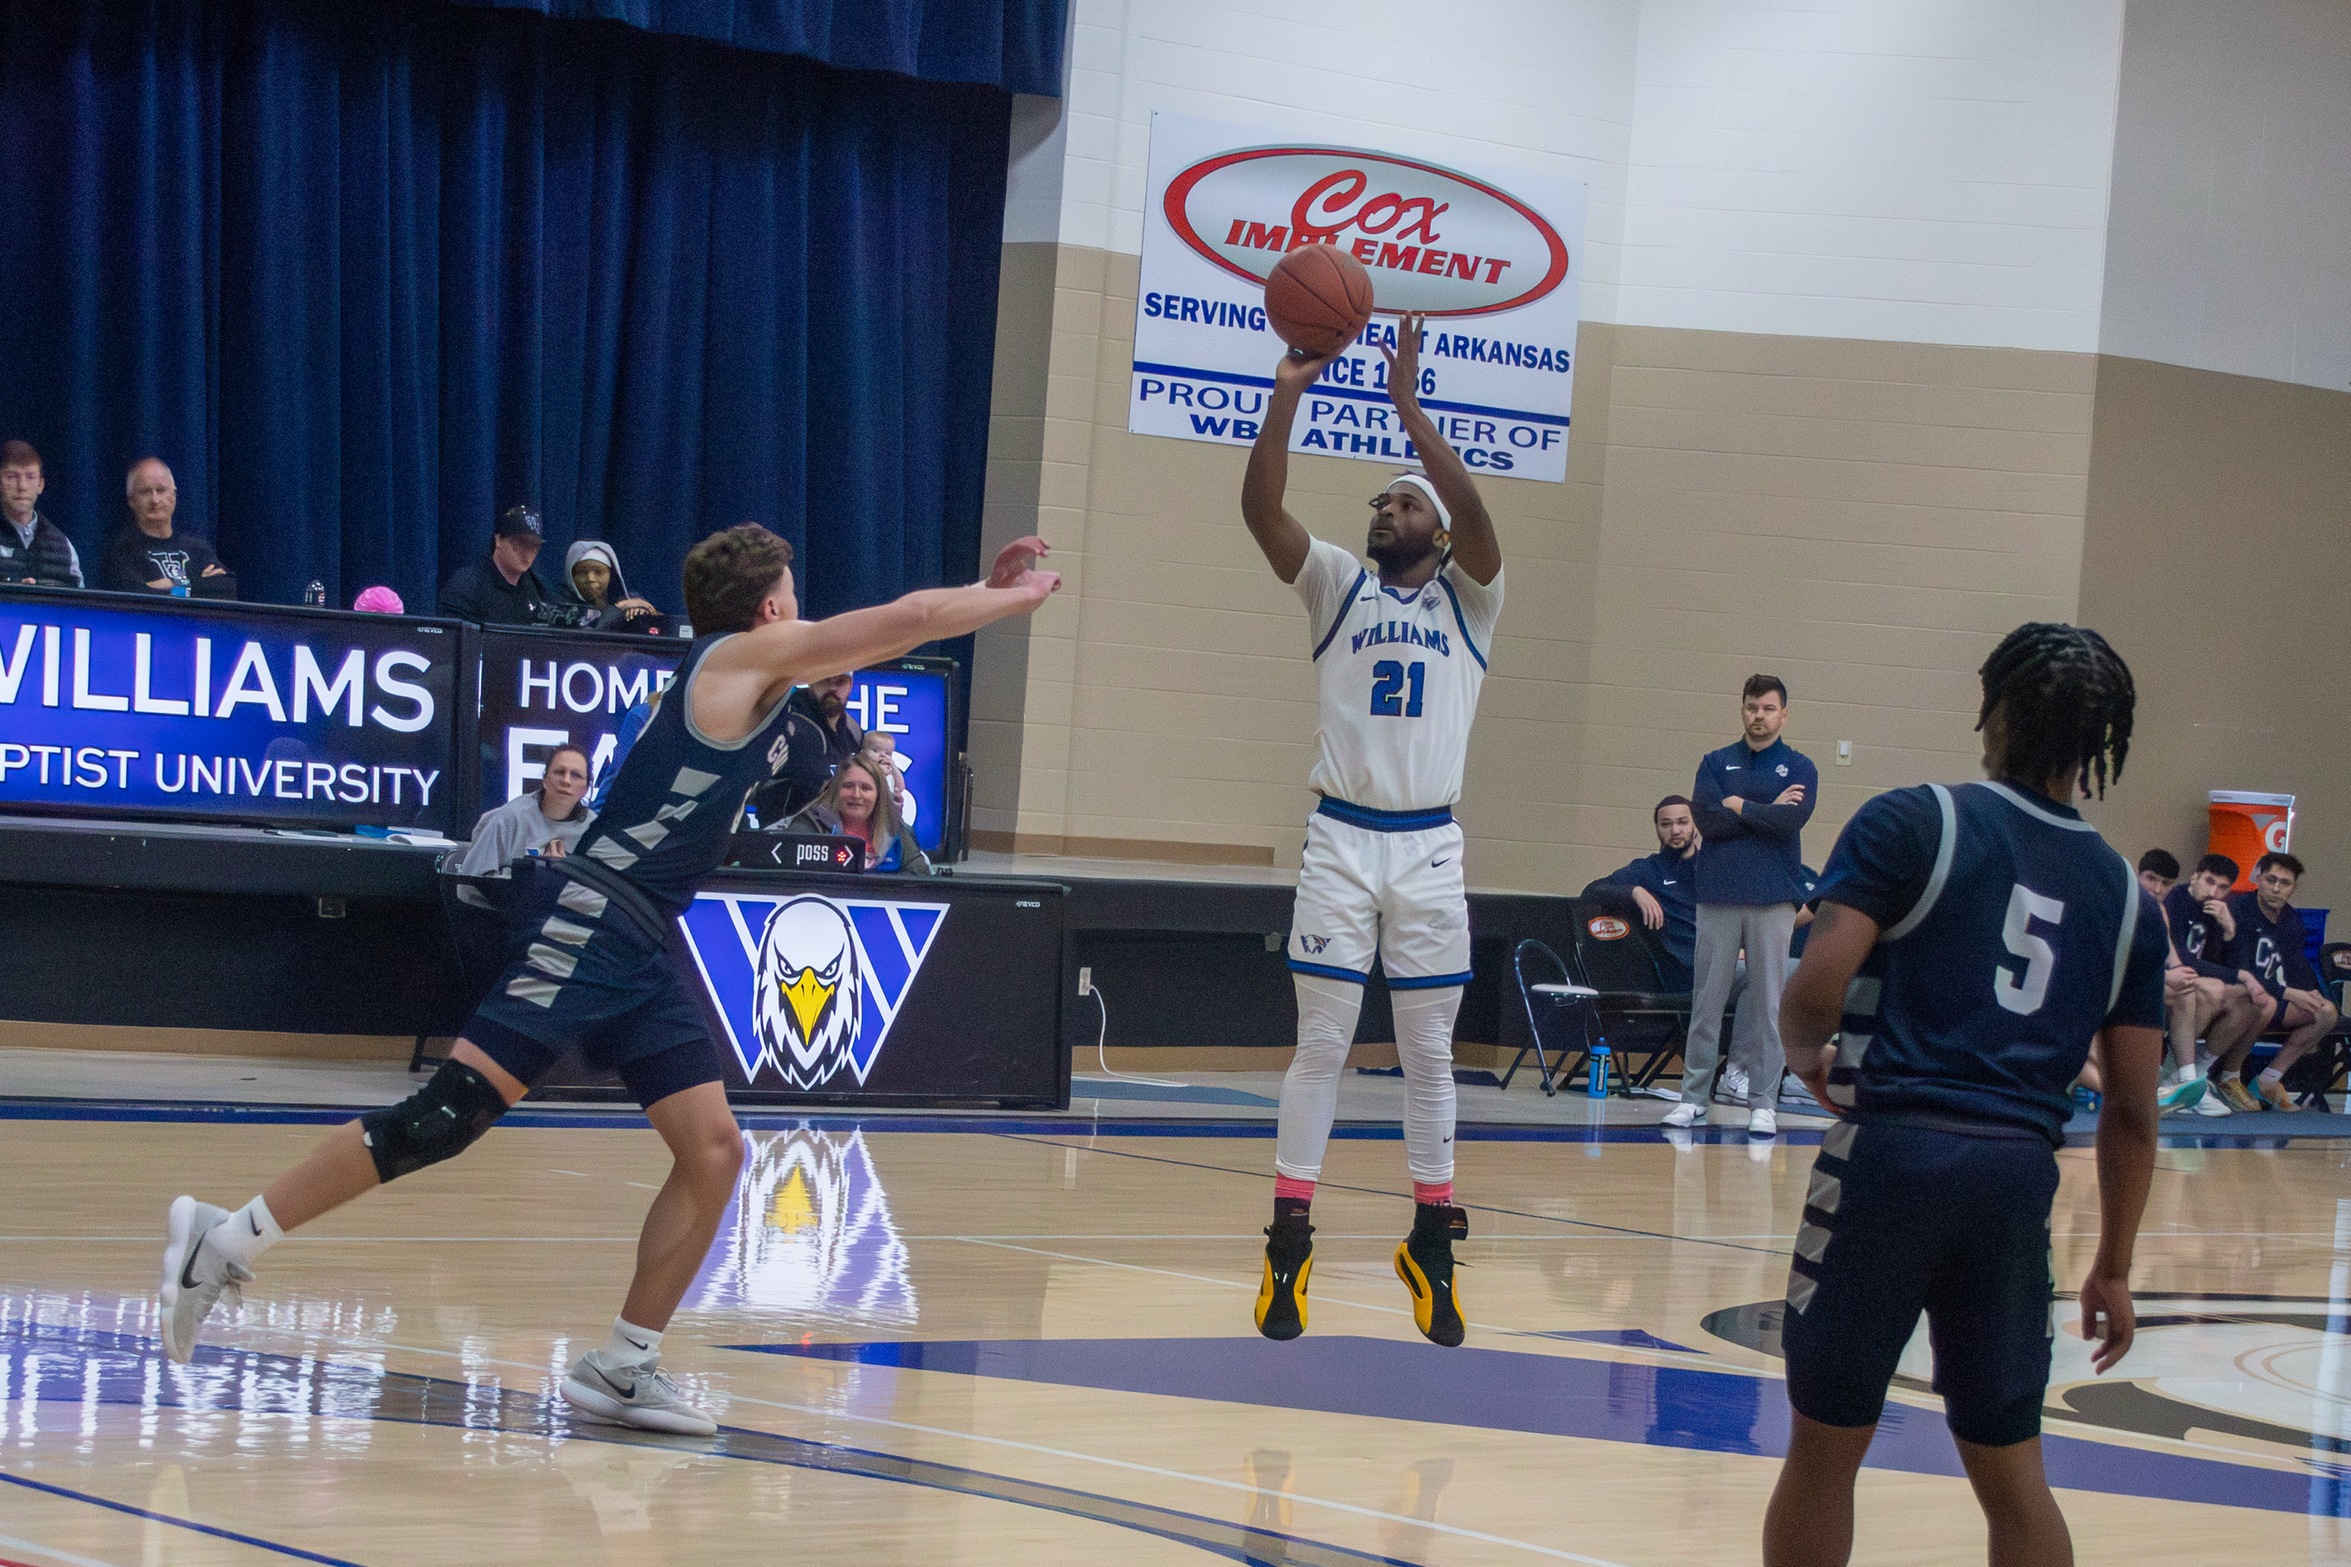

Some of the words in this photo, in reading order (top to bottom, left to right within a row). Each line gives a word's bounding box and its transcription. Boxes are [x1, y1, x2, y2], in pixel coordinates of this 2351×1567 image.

[1144, 292, 1266, 332] SERVING
[1434, 333, 1570, 374] ARKANSAS
[1140, 378, 1272, 415] PROU
[1508, 426, 1561, 451] OF
[1189, 414, 1260, 440] WB
[1351, 620, 1450, 658] WILLIAMS
[1370, 660, 1425, 717] 21
[0, 743, 139, 789] PTIST
[155, 752, 440, 806] UNIVERSITY
[1994, 883, 2064, 1016] 5
